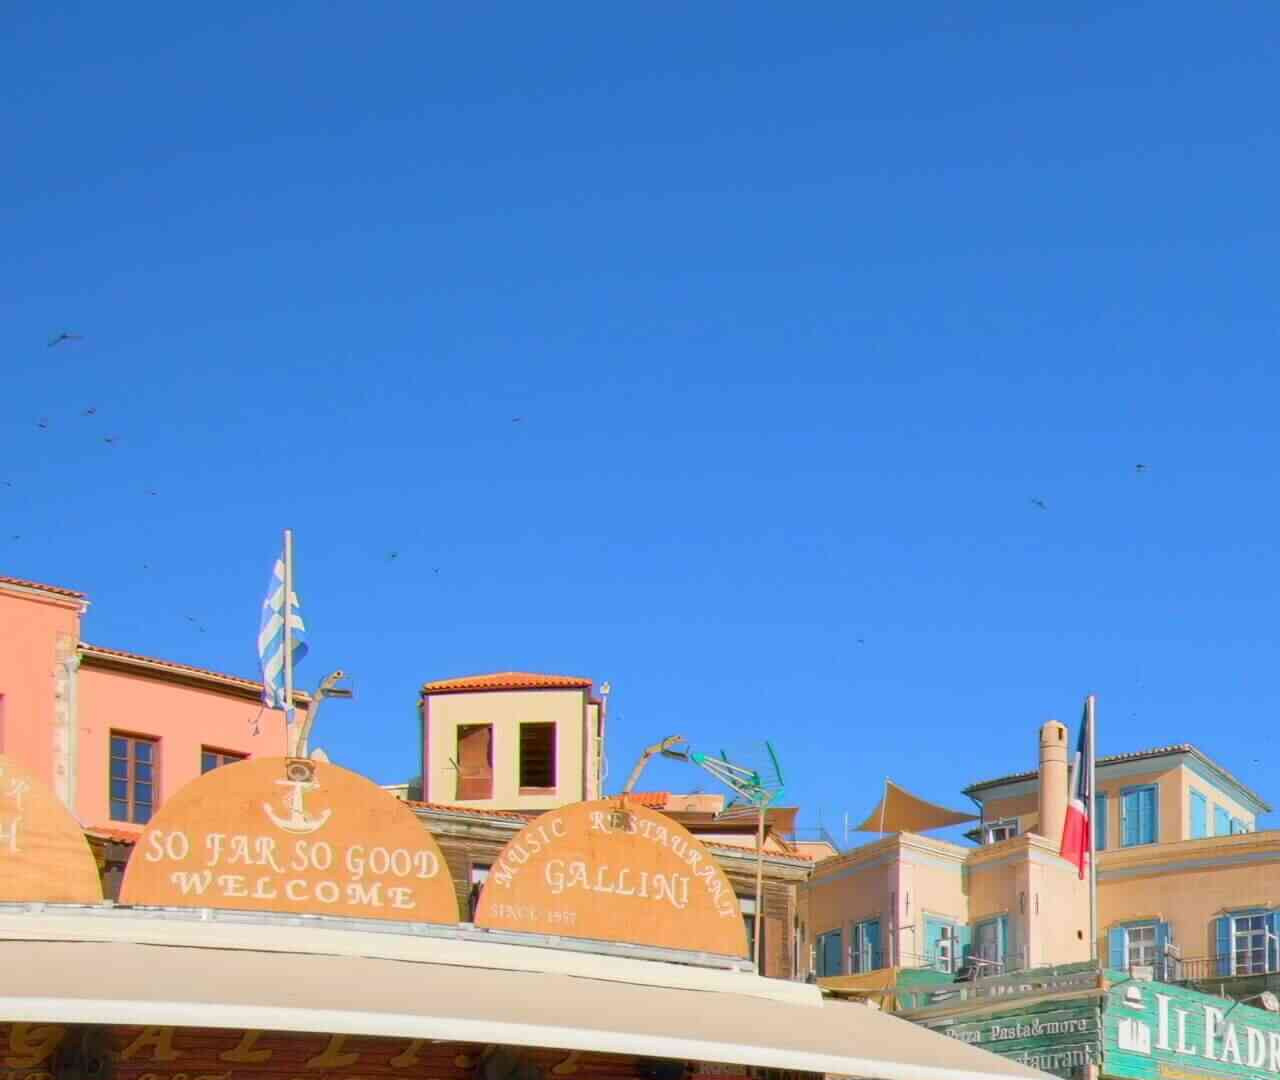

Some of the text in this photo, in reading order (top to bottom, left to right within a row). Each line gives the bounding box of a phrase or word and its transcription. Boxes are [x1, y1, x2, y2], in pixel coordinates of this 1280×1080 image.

[145, 830, 440, 881] SO FAR SO GOOD
[495, 810, 737, 918] MUSIC RESTAURANT
[169, 870, 417, 910] WELCOME
[543, 858, 691, 909] GALLINI
[1155, 993, 1196, 1056] IL
